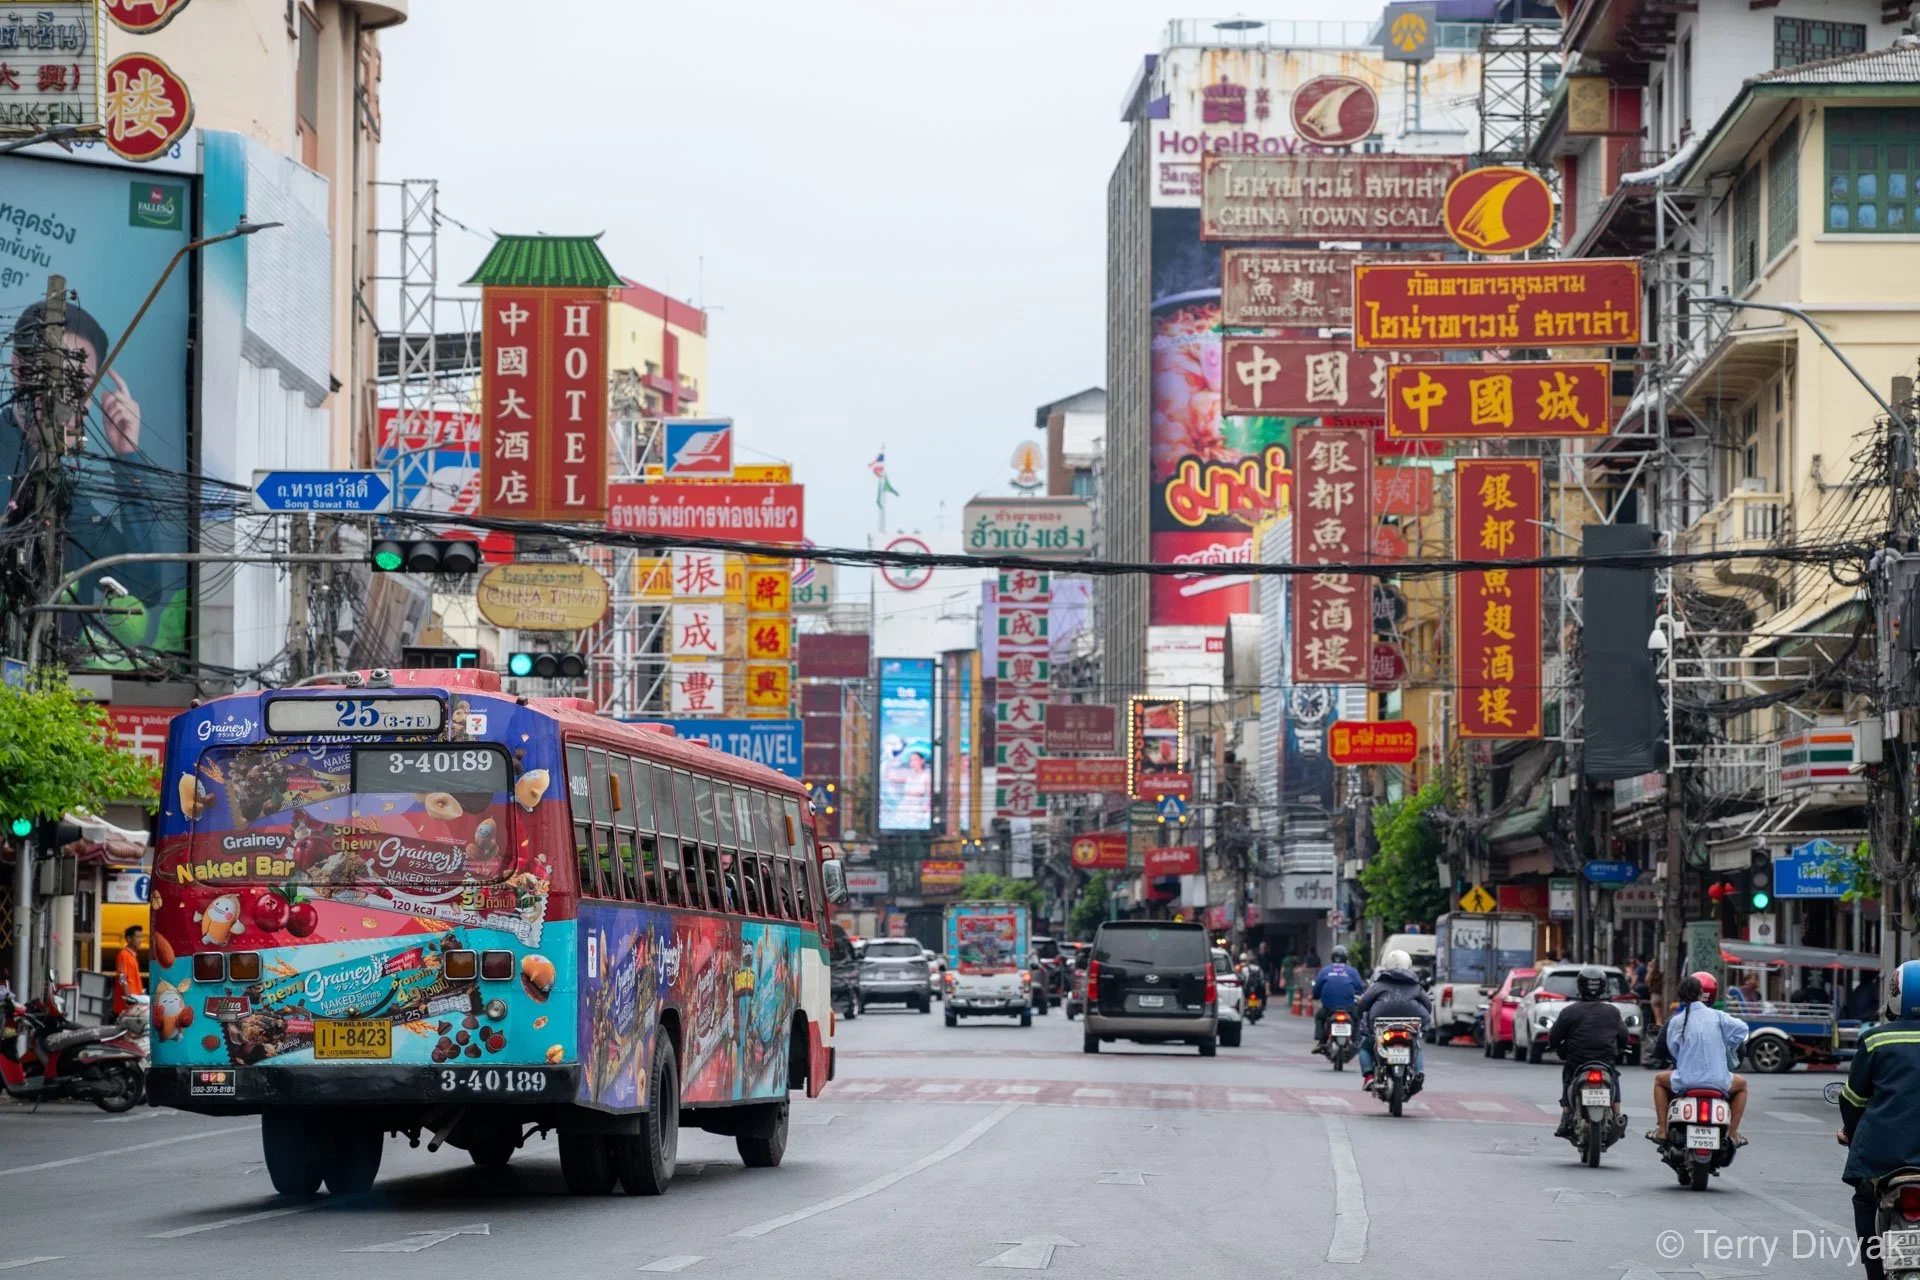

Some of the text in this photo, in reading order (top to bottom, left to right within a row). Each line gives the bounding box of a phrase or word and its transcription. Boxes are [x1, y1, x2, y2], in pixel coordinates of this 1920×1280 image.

[1218, 207, 1290, 227] CHINA
[1301, 207, 1369, 227] TOWN
[494, 302, 532, 505] 中國大酒店
[563, 305, 590, 506] HOTEL
[1401, 370, 1591, 432] 中國城
[284, 499, 309, 510] Song
[312, 499, 342, 510] Sawat
[334, 699, 380, 727] 25
[197, 719, 247, 742] Grainey
[728, 733, 798, 764] TRAVEL
[389, 750, 493, 774] 3-40189
[223, 833, 286, 850] Grainey
[378, 836, 452, 873] Grainey
[176, 855, 297, 885] Naked Bar
[387, 869, 424, 884] NAKED
[391, 900, 437, 916] 120 kcal
[304, 964, 373, 1003] Grainey
[320, 993, 356, 1011] NAKED
[322, 1028, 387, 1047] 11-8423
[440, 1071, 547, 1092] 3-40189
